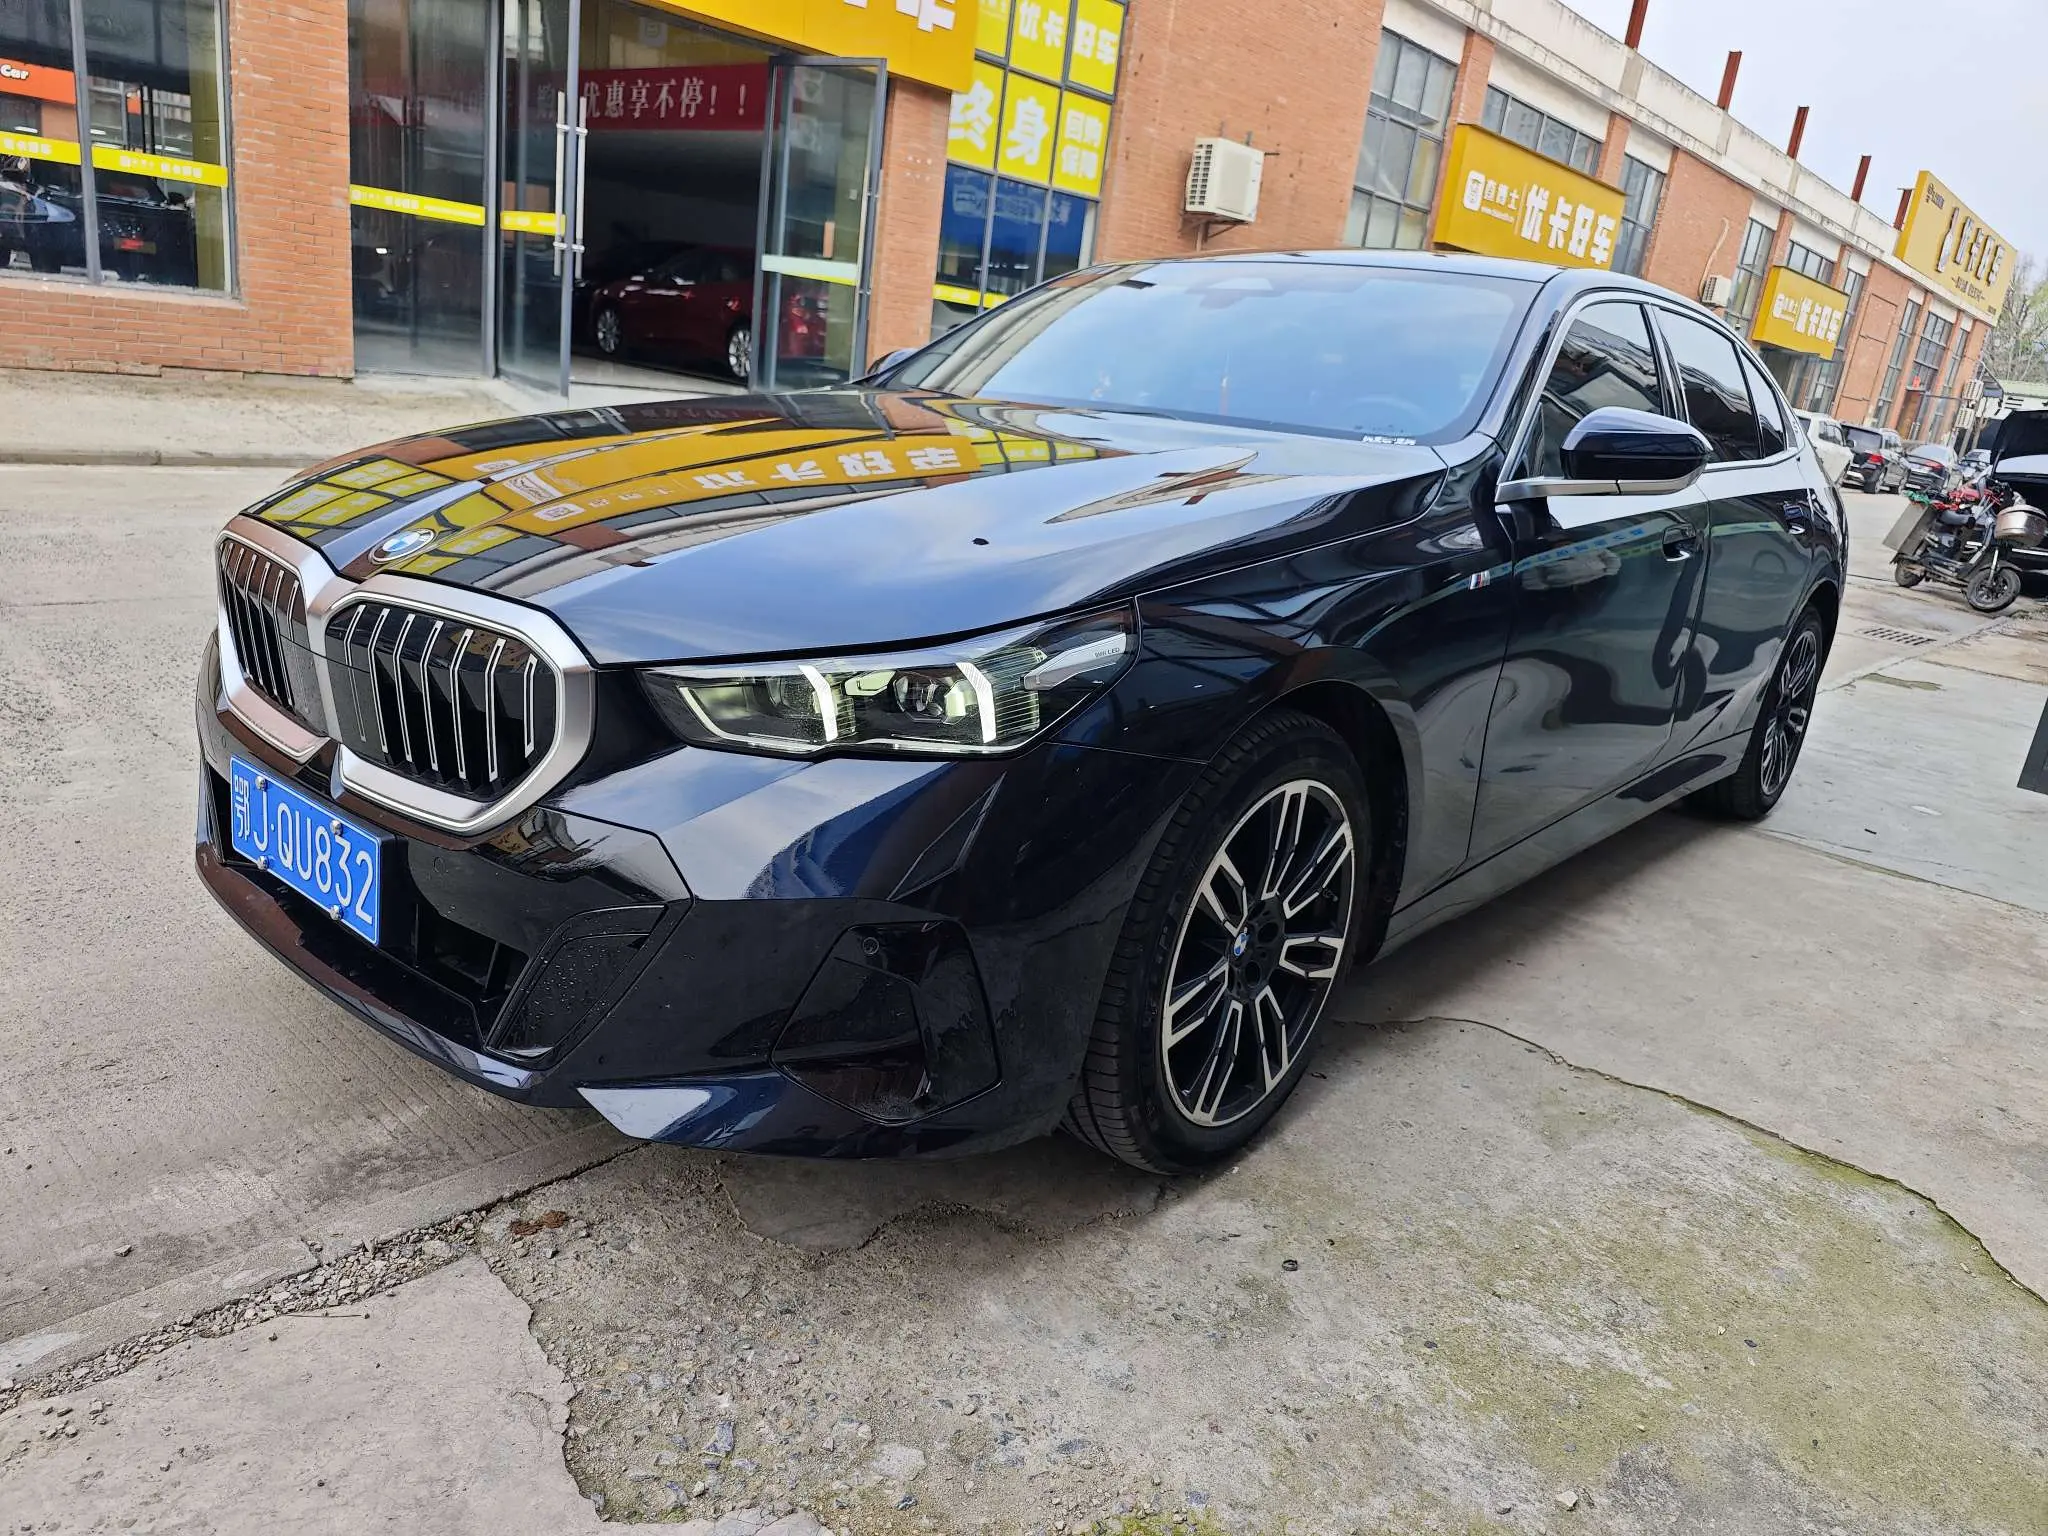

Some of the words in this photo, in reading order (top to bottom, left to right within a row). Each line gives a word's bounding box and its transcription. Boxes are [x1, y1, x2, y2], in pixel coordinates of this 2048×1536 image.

[0, 64, 29, 80] Car
[948, 80, 1050, 166] 终身
[1521, 184, 1616, 265] 优卡好车
